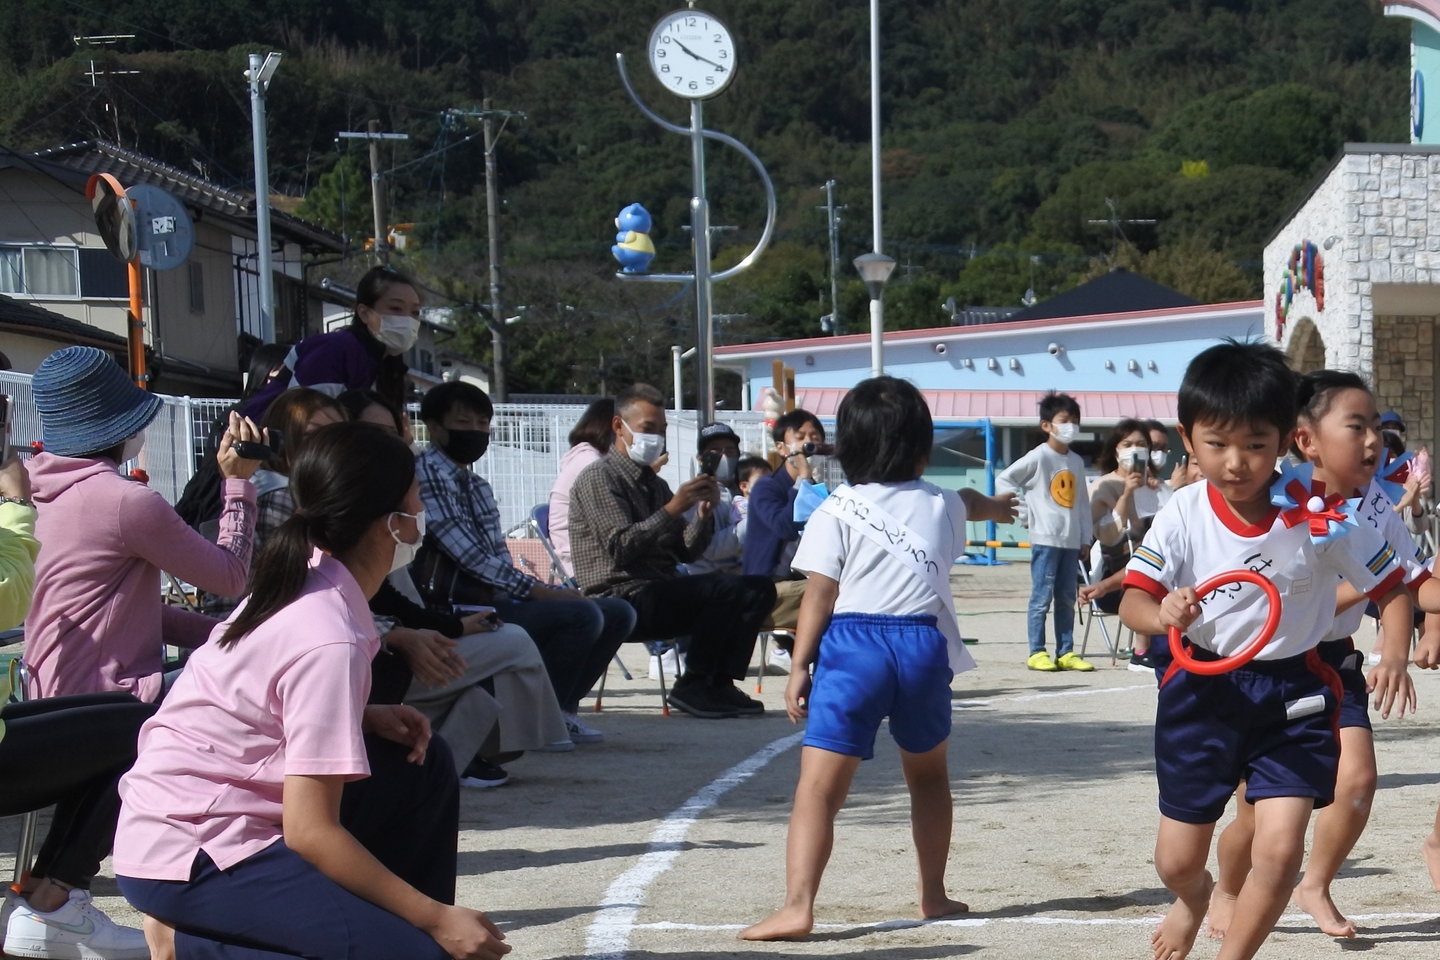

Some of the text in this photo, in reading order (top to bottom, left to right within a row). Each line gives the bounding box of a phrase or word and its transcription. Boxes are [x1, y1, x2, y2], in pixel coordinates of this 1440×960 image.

[684, 17, 697, 27] 12
[669, 23, 680, 32] 11
[659, 35, 671, 44] 10
[713, 34, 722, 43] 2
[656, 49, 666, 58] 9
[718, 49, 727, 59] 3
[661, 63, 671, 73] 8
[714, 64, 724, 72] 4
[673, 76, 683, 85] 7
[688, 80, 698, 90] 6
[705, 76, 715, 85] 5
[829, 493, 939, 577] まつおしんごろう
